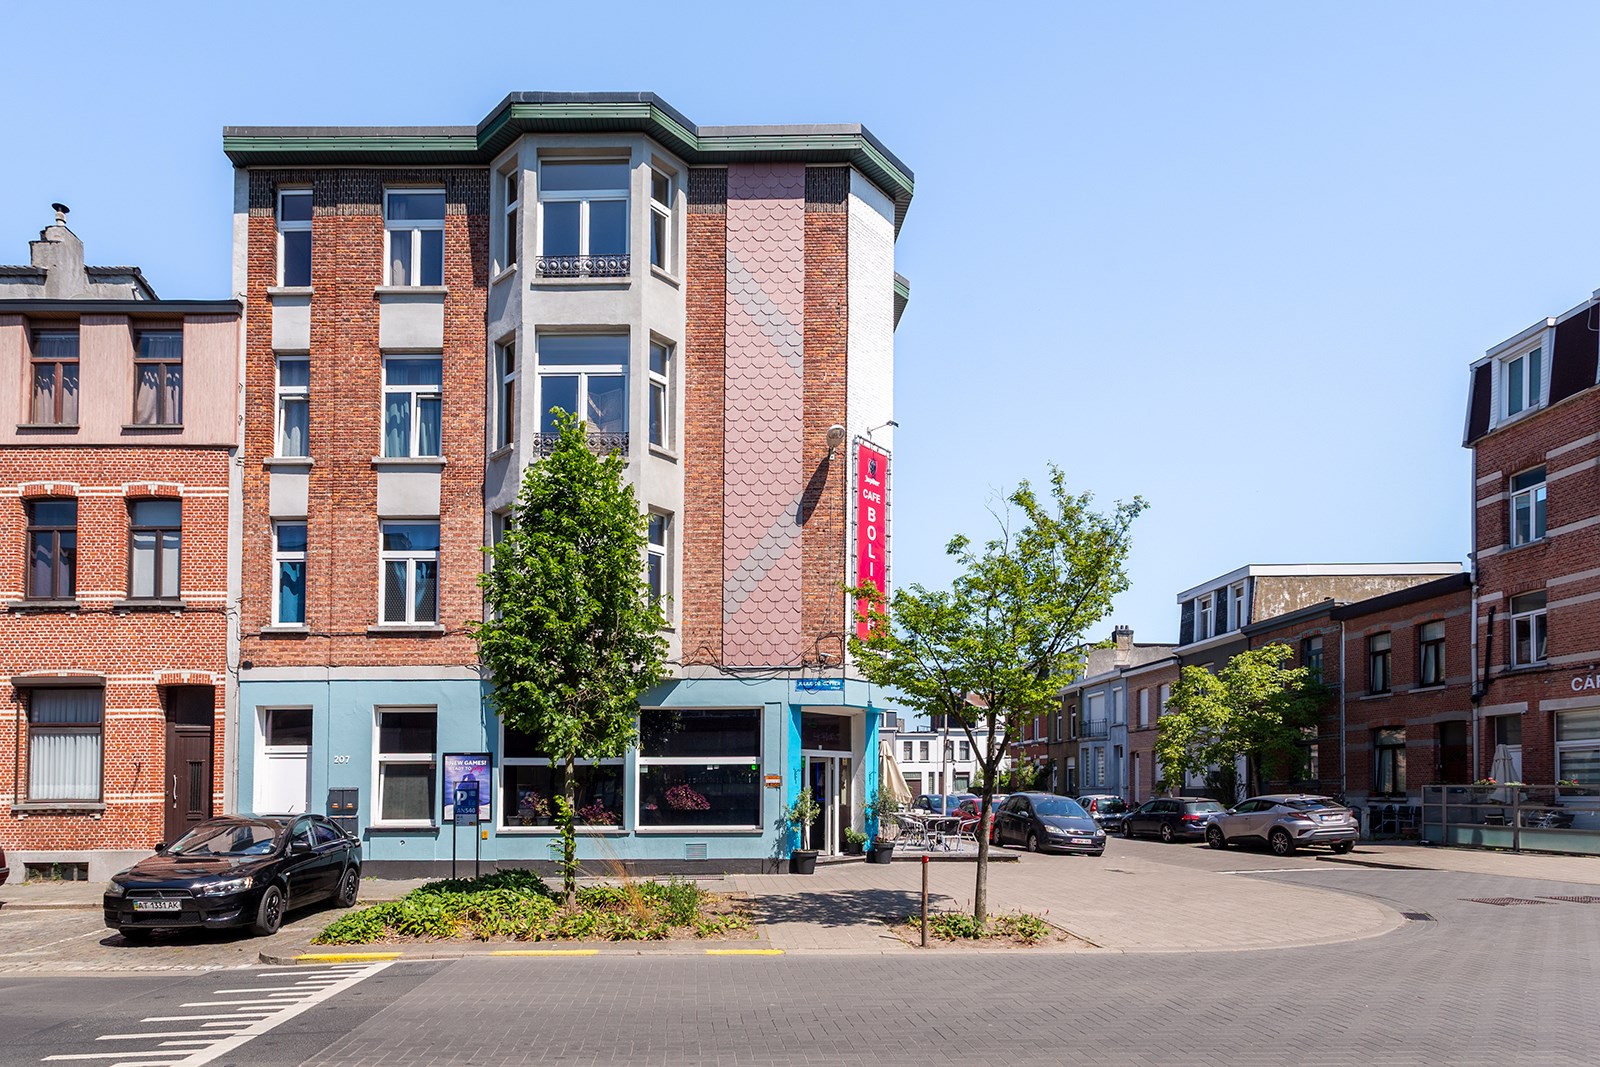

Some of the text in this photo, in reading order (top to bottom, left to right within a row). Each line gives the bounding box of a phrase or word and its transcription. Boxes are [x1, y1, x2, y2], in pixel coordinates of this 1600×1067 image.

[863, 488, 881, 504] CAFE
[334, 755, 350, 764] 207
[456, 790, 467, 806] P
